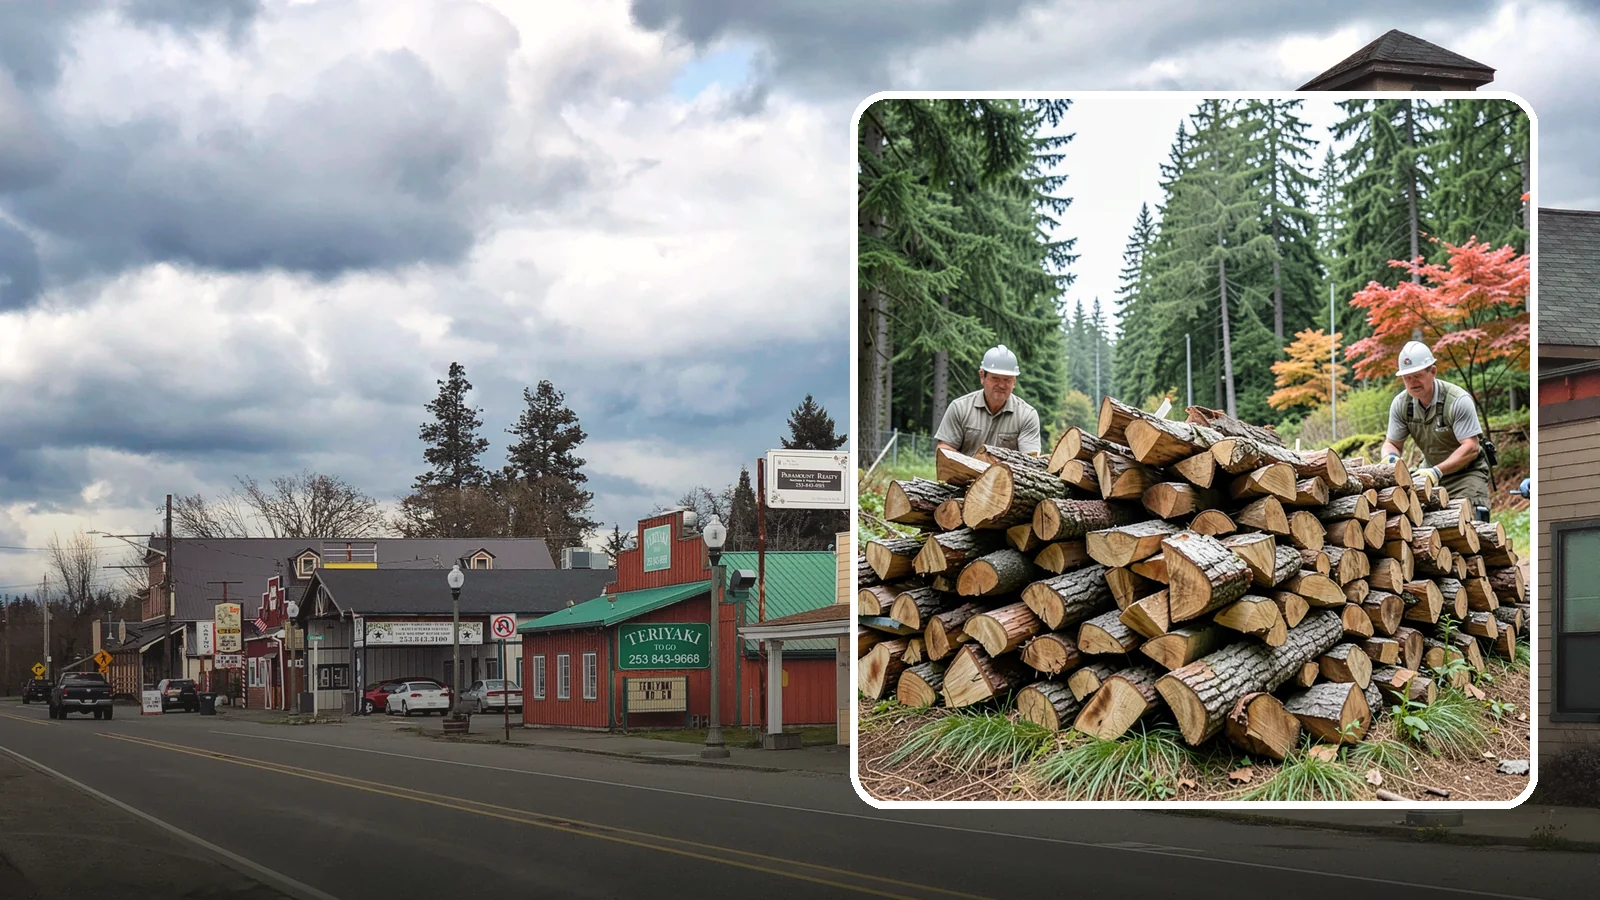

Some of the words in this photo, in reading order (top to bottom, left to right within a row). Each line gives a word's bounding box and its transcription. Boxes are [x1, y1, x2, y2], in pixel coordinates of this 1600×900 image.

[625, 628, 702, 645] TERIYAKI
[628, 654, 648, 664] 253
[651, 654, 700, 664] 843-9668
